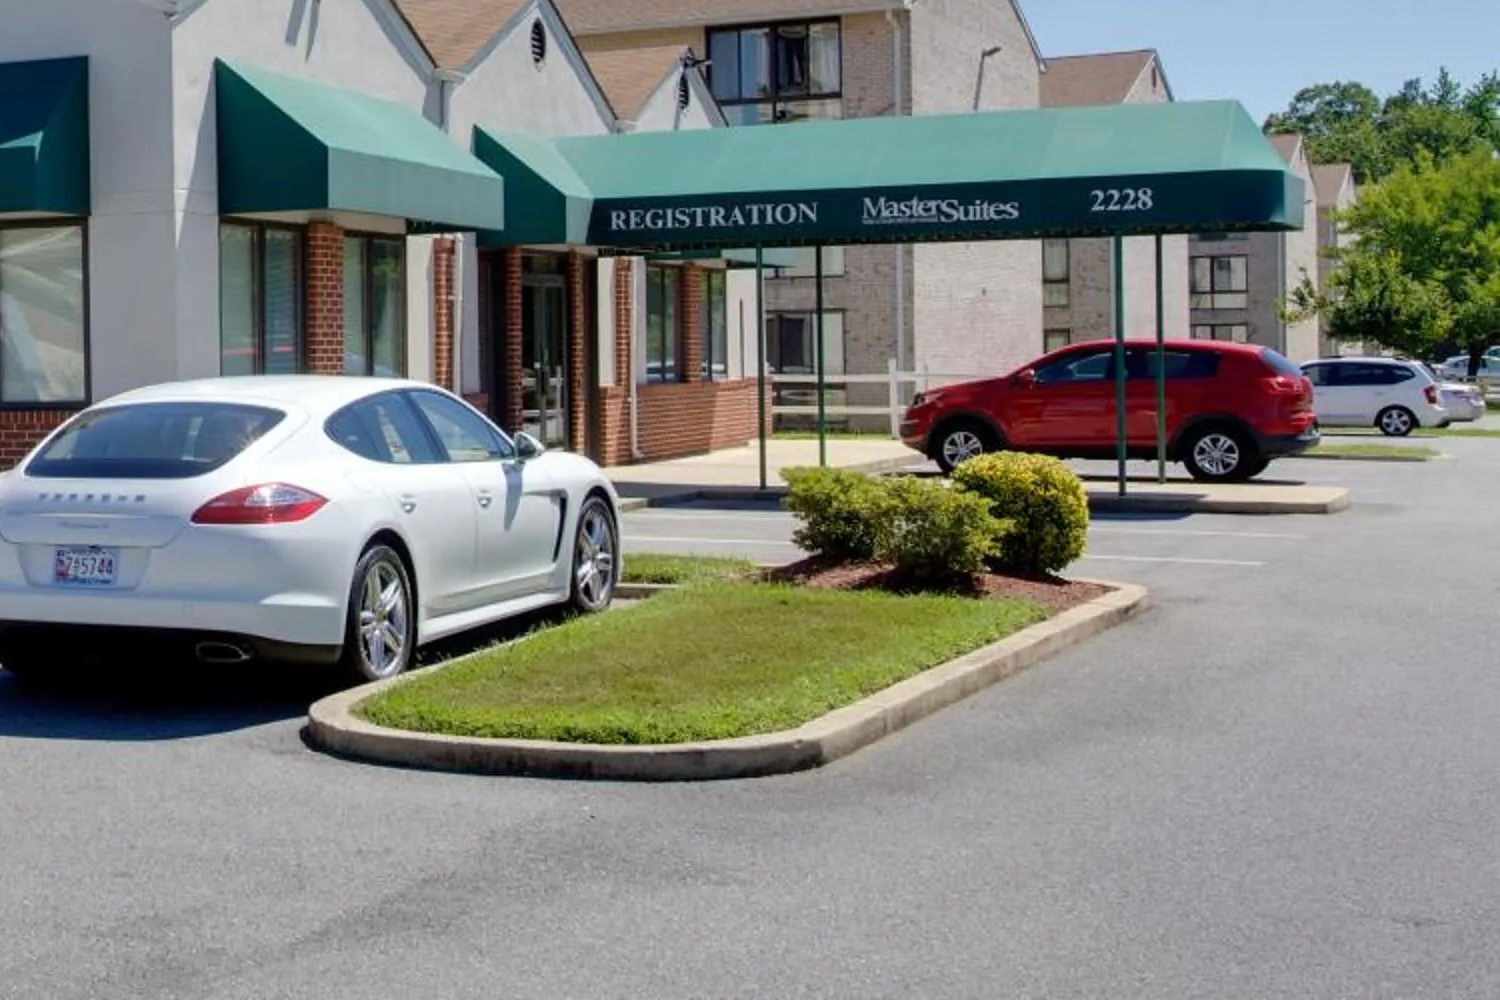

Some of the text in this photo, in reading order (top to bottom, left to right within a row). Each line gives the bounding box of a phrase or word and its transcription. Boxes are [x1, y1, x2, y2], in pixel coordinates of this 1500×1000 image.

[862, 196, 1019, 221] MasterSuites
[1091, 188, 1153, 211] 2228
[611, 202, 818, 230] REGISTRATION
